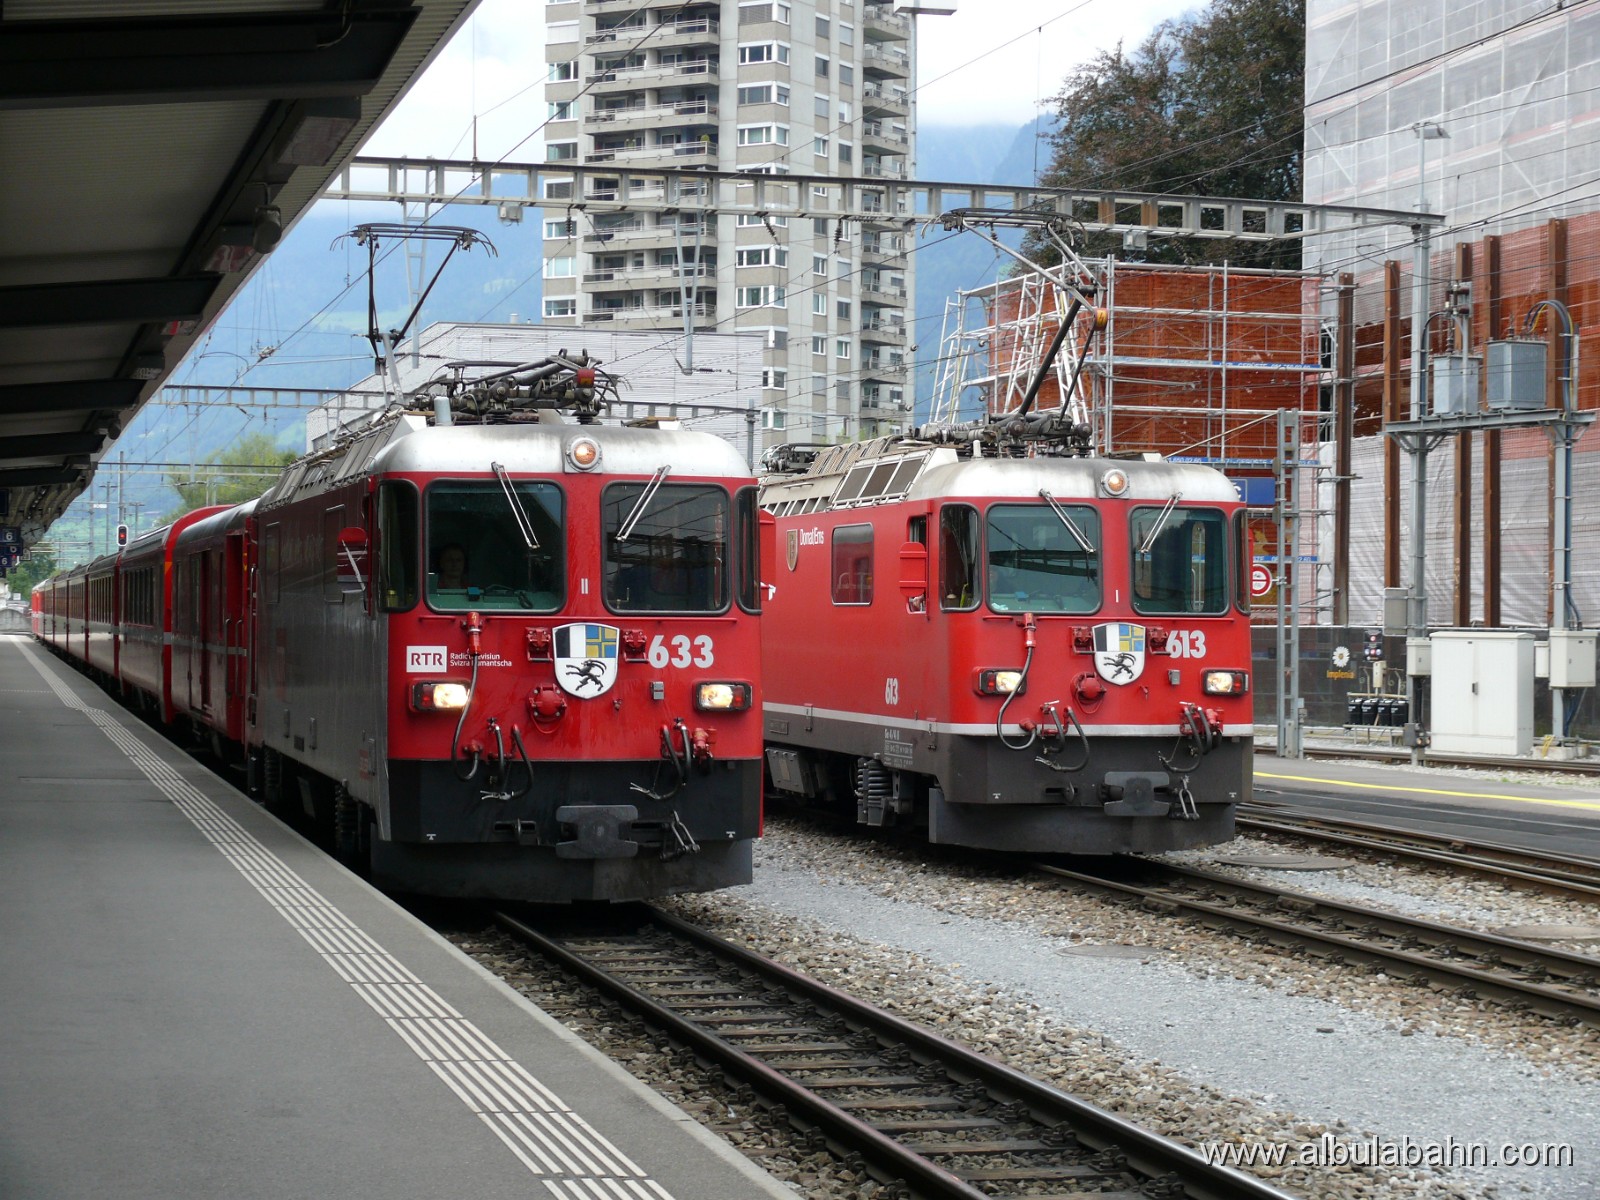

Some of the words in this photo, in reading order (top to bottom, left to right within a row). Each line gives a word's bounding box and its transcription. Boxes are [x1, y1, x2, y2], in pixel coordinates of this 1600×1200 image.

[6, 532, 13, 541] 6
[1, 557, 8, 565] 6
[648, 634, 714, 669] 633
[1165, 630, 1207, 659] 613
[411, 652, 443, 666] RTR
[450, 659, 470, 667] Svizra
[471, 659, 513, 667] mantscha
[885, 678, 899, 706] 613
